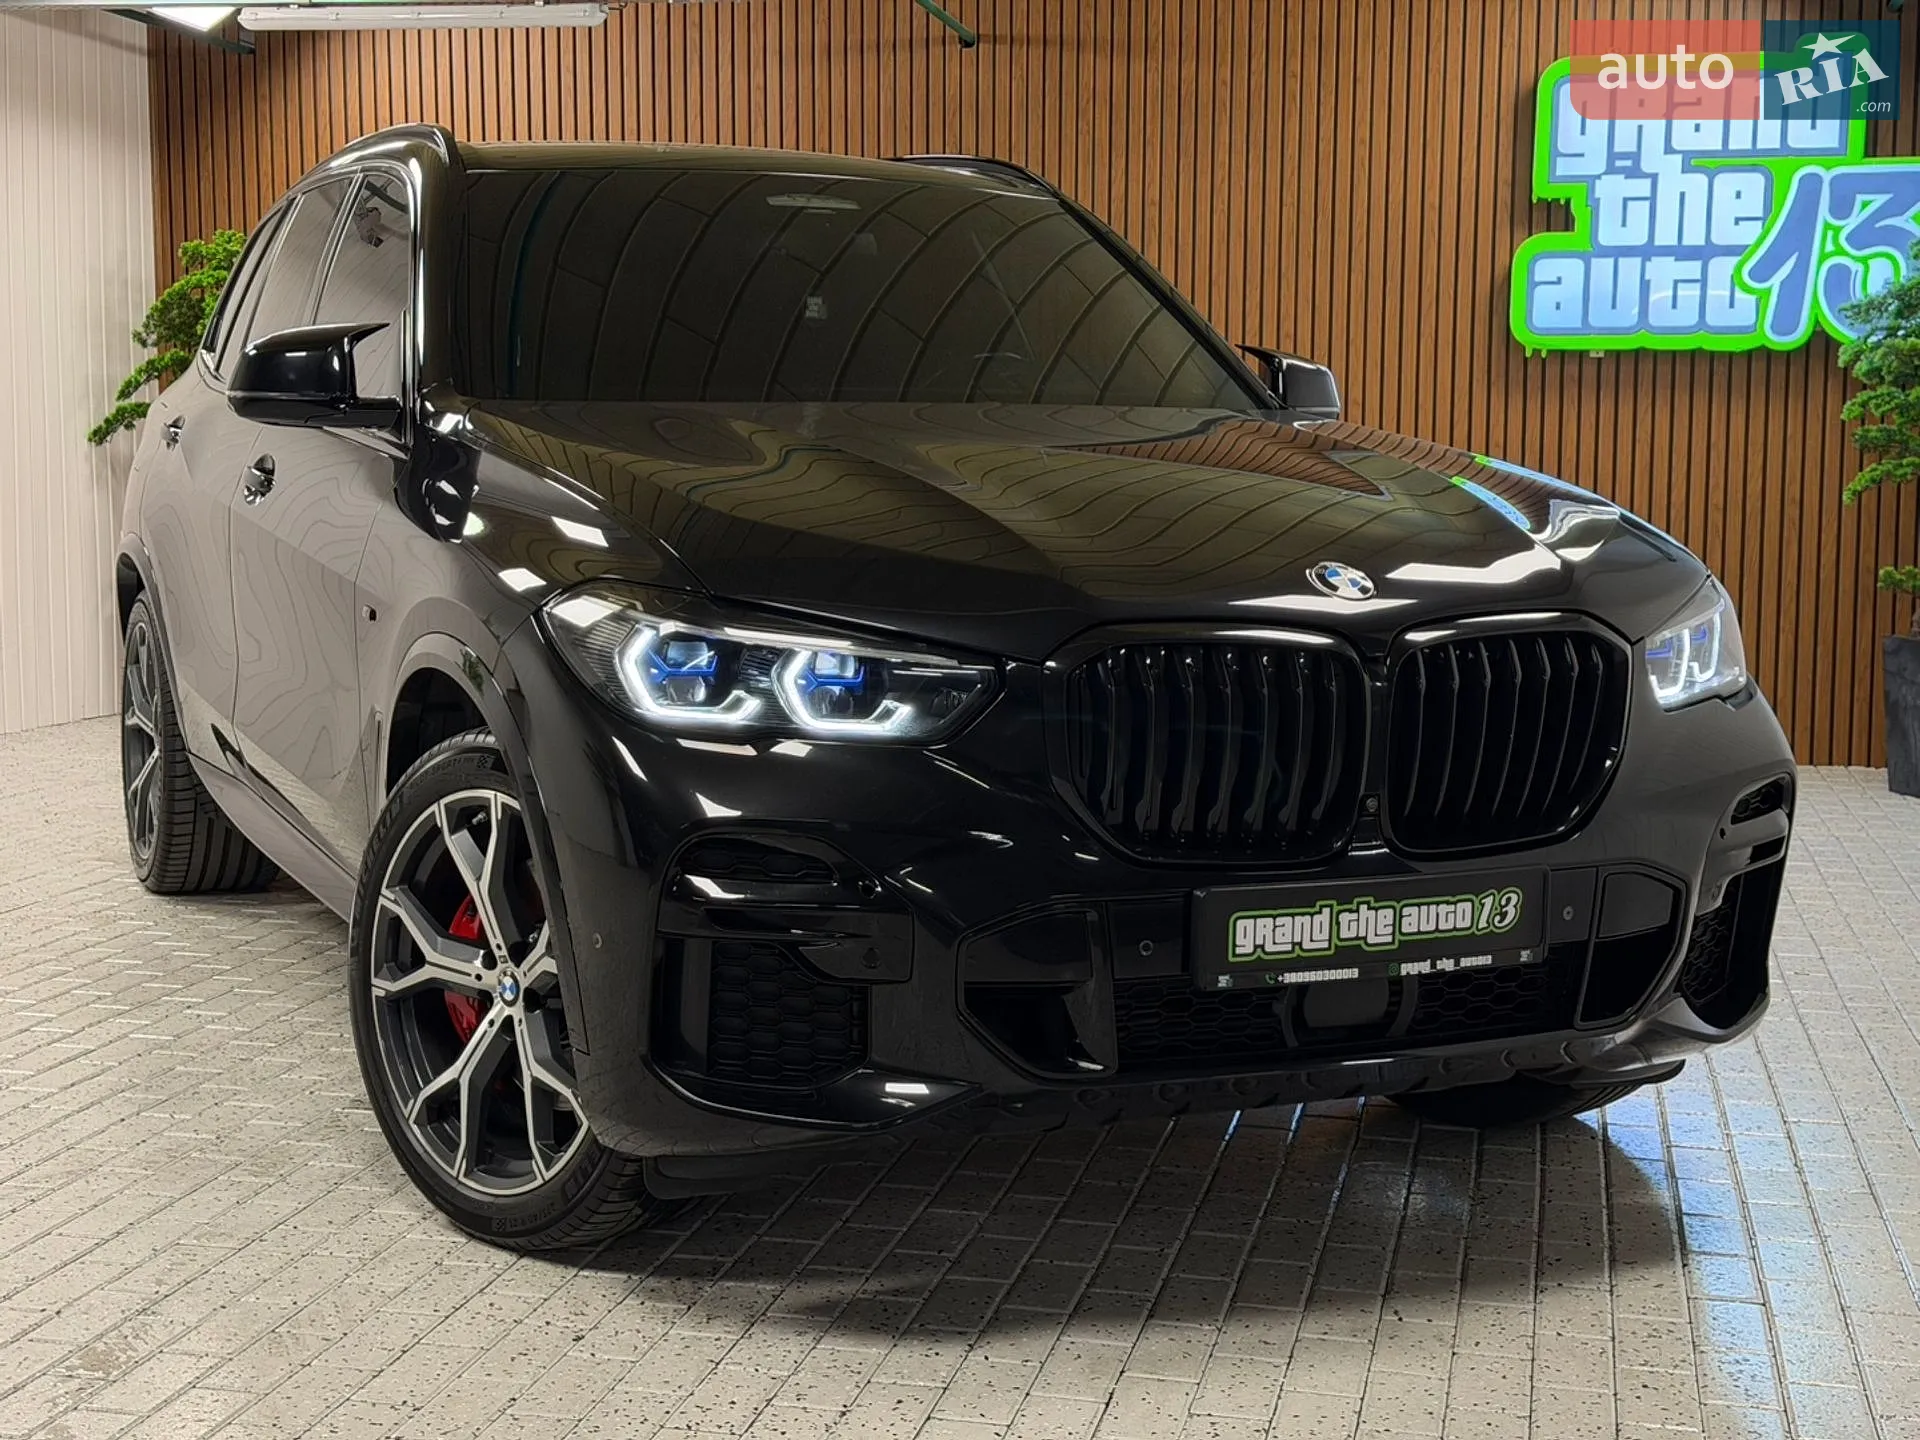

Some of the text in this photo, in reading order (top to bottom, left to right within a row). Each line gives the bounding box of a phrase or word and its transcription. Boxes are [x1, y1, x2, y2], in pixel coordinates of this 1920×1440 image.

[1594, 153, 1767, 246] the
[1532, 255, 1758, 328] auto
[1234, 906, 1331, 955] grand
[1339, 903, 1395, 944] the
